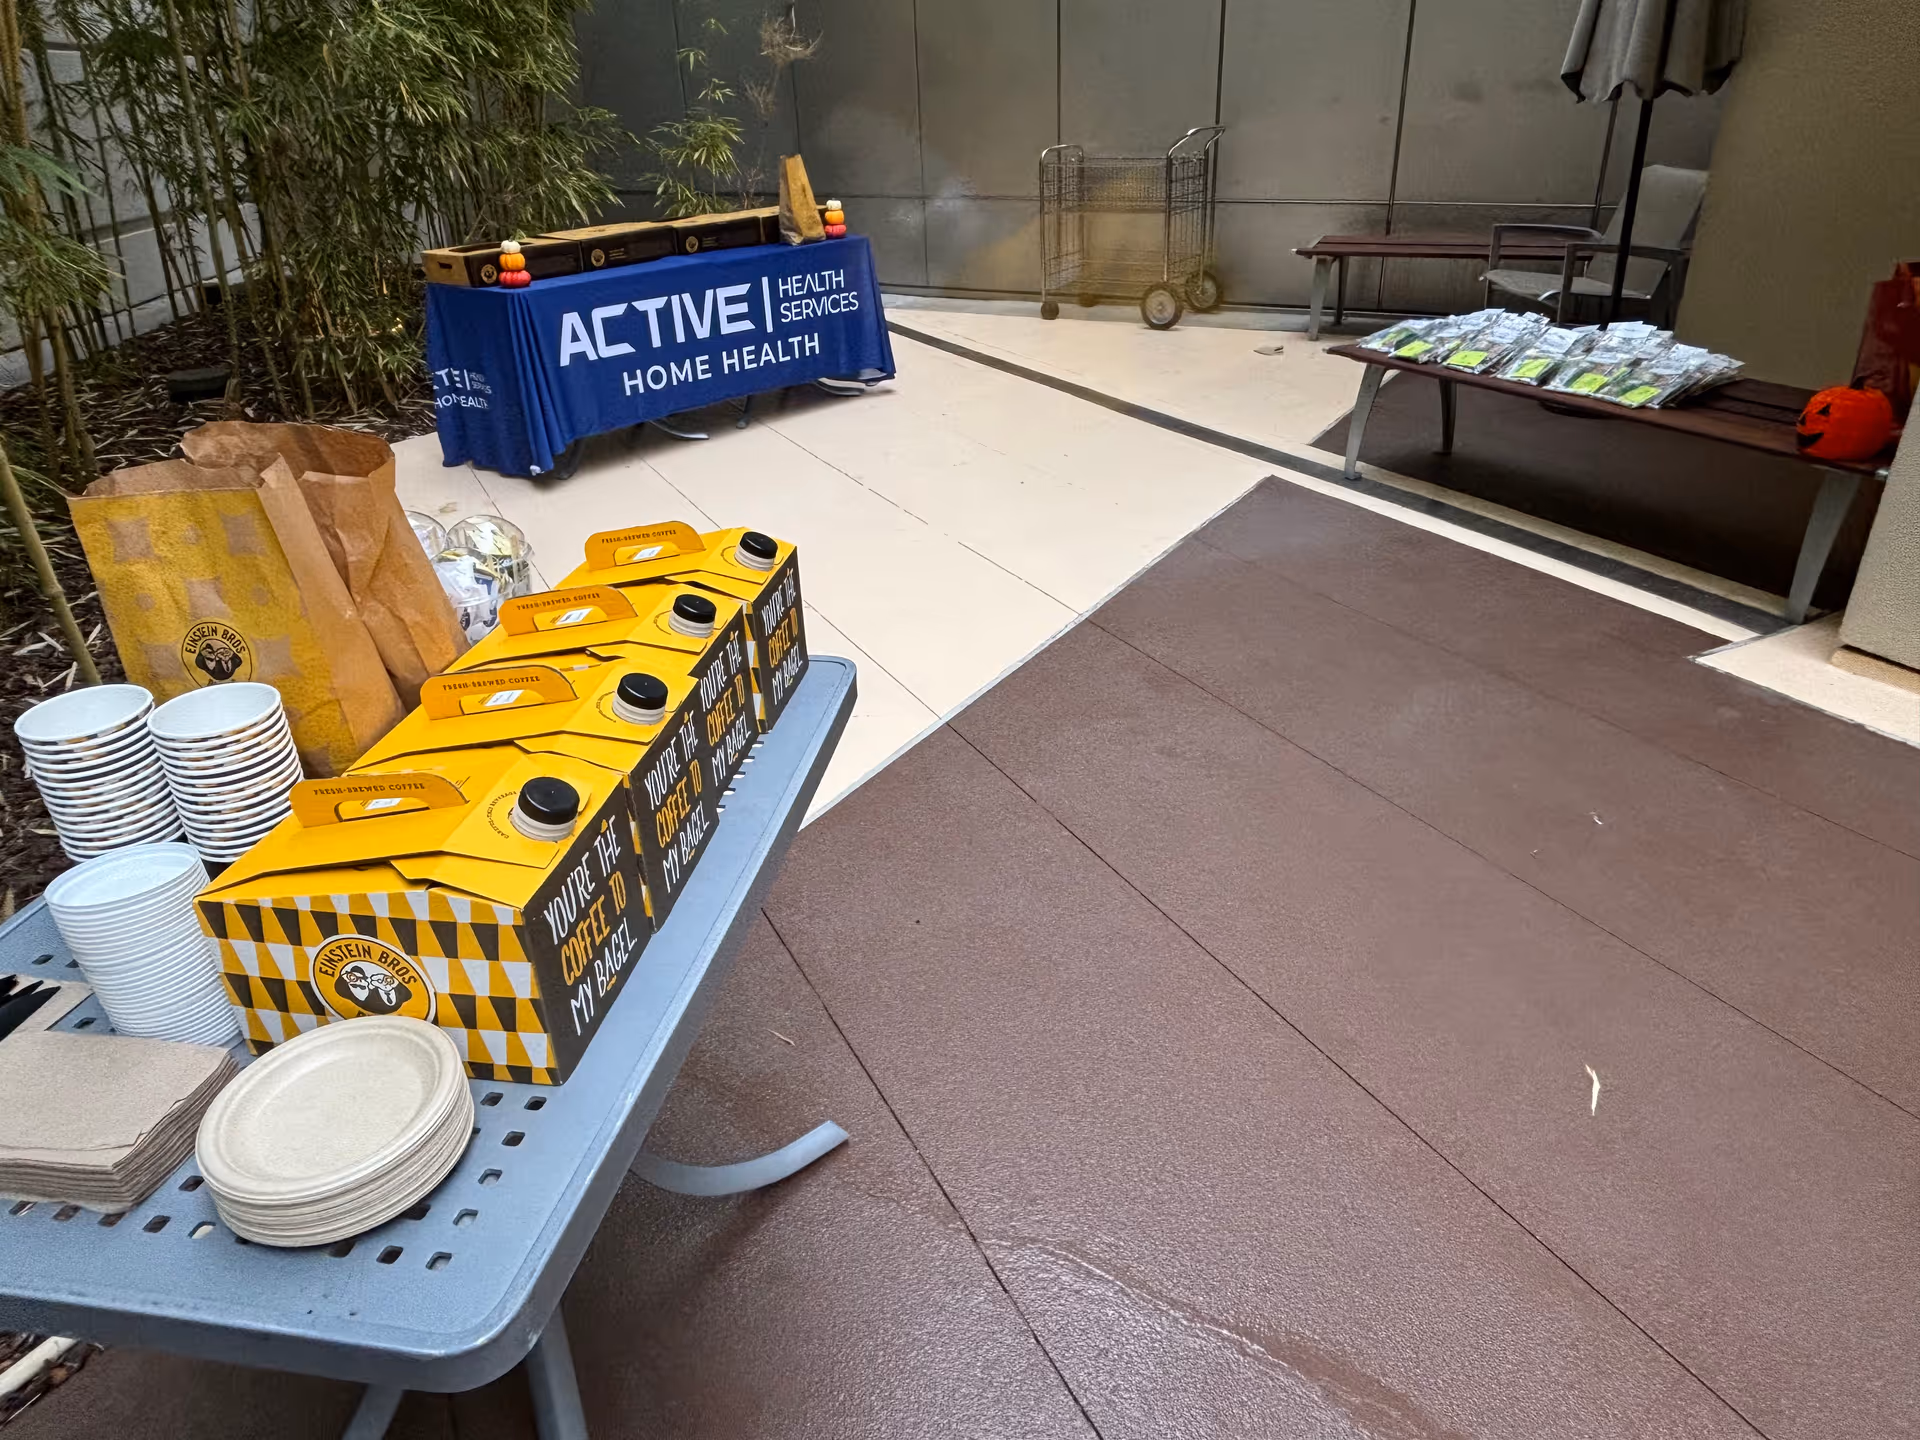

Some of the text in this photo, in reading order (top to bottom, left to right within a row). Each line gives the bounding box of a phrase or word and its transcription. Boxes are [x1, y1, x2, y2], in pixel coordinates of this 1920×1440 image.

[779, 269, 845, 298] HEALTH
[780, 291, 859, 323] SERVICES
[560, 283, 756, 367] ACTIVE
[623, 333, 820, 396] HOME HEALTH
[761, 568, 797, 636] YOU'RE THE
[221, 628, 246, 654] BROS
[725, 629, 742, 676] THE
[768, 607, 799, 668] COFFEE TO
[706, 674, 746, 748] COFFEE TO
[772, 671, 785, 706] MY
[313, 782, 426, 796] FRESH-BREWED COFFEE
[644, 710, 699, 811] YOU'RE THE
[712, 748, 727, 787] MY
[656, 759, 703, 848] COFFEE TO
[543, 815, 622, 945] YOU'RE THE
[662, 844, 680, 894] MY
[561, 870, 627, 986] COFFEE TO
[319, 943, 417, 985] EINSTEIN BROS
[570, 917, 638, 1037] MY BAGEL.
